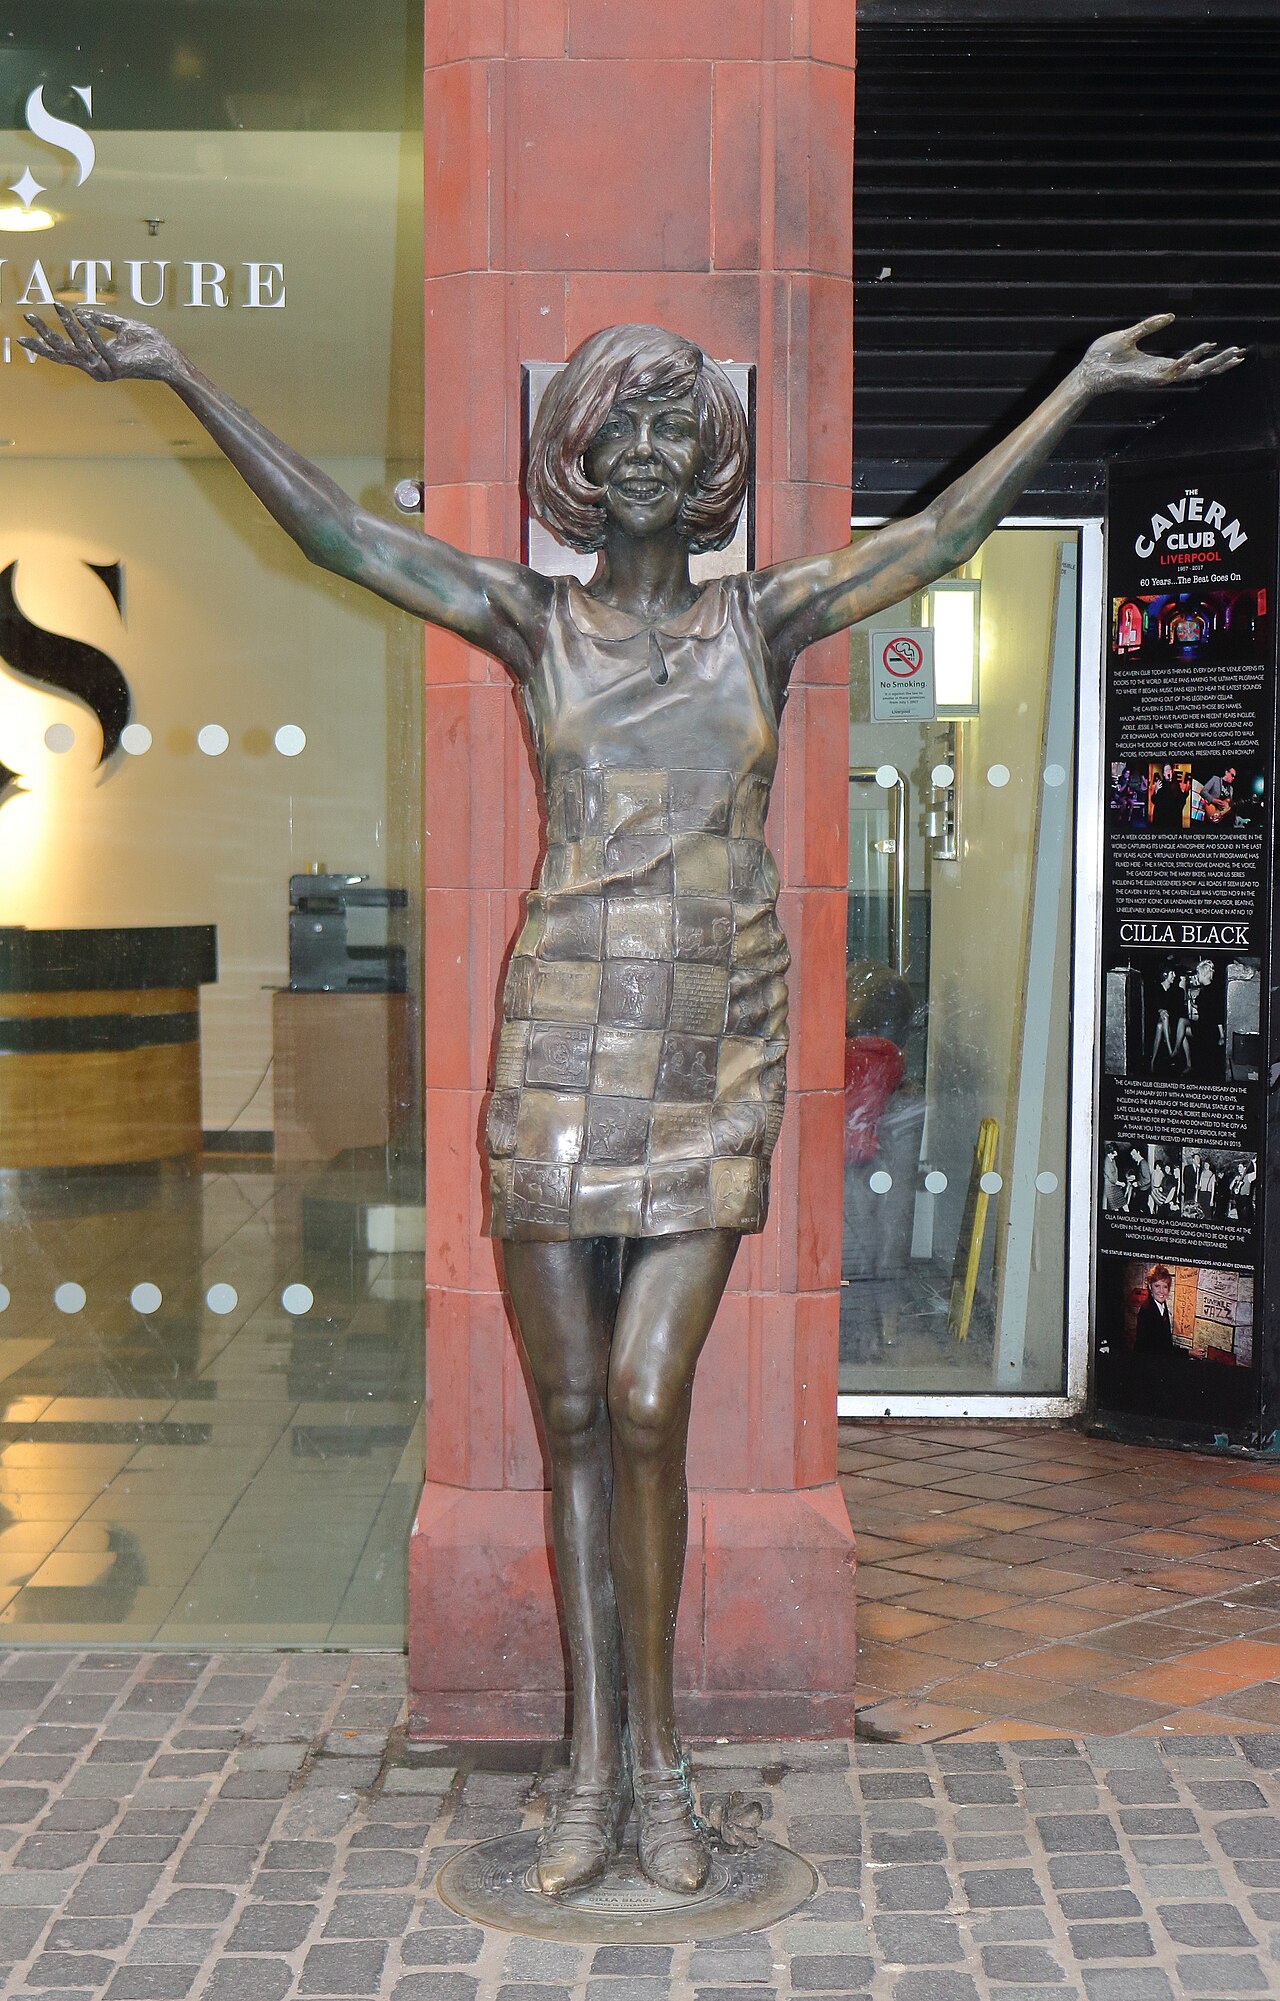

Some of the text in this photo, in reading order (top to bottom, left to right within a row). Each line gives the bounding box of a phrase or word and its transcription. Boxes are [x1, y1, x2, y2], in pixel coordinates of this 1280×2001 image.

[25, 85, 96, 187] S
[0, 259, 286, 308] ATURE
[1135, 498, 1248, 558] CAVERN
[1166, 532, 1216, 550] CLUB
[1160, 552, 1222, 565] LIVERPOOL
[1140, 578, 1150, 587] 60
[1193, 575, 1209, 584] Beat
[1210, 574, 1228, 582] Goes
[1230, 573, 1241, 581] On
[1120, 924, 1249, 944] CILLA BLACK
[1198, 1085, 1229, 1093] ANNIVERSARY
[1116, 1214, 1138, 1222] FAMOUSLY
[1108, 1248, 1122, 1256] STATUE
[1132, 1251, 1149, 1259] CREATED
[1164, 1254, 1179, 1262] ARTISTS
[1192, 1257, 1211, 1266] RODGERS
[1204, 1305, 1233, 1320] JAZZ
